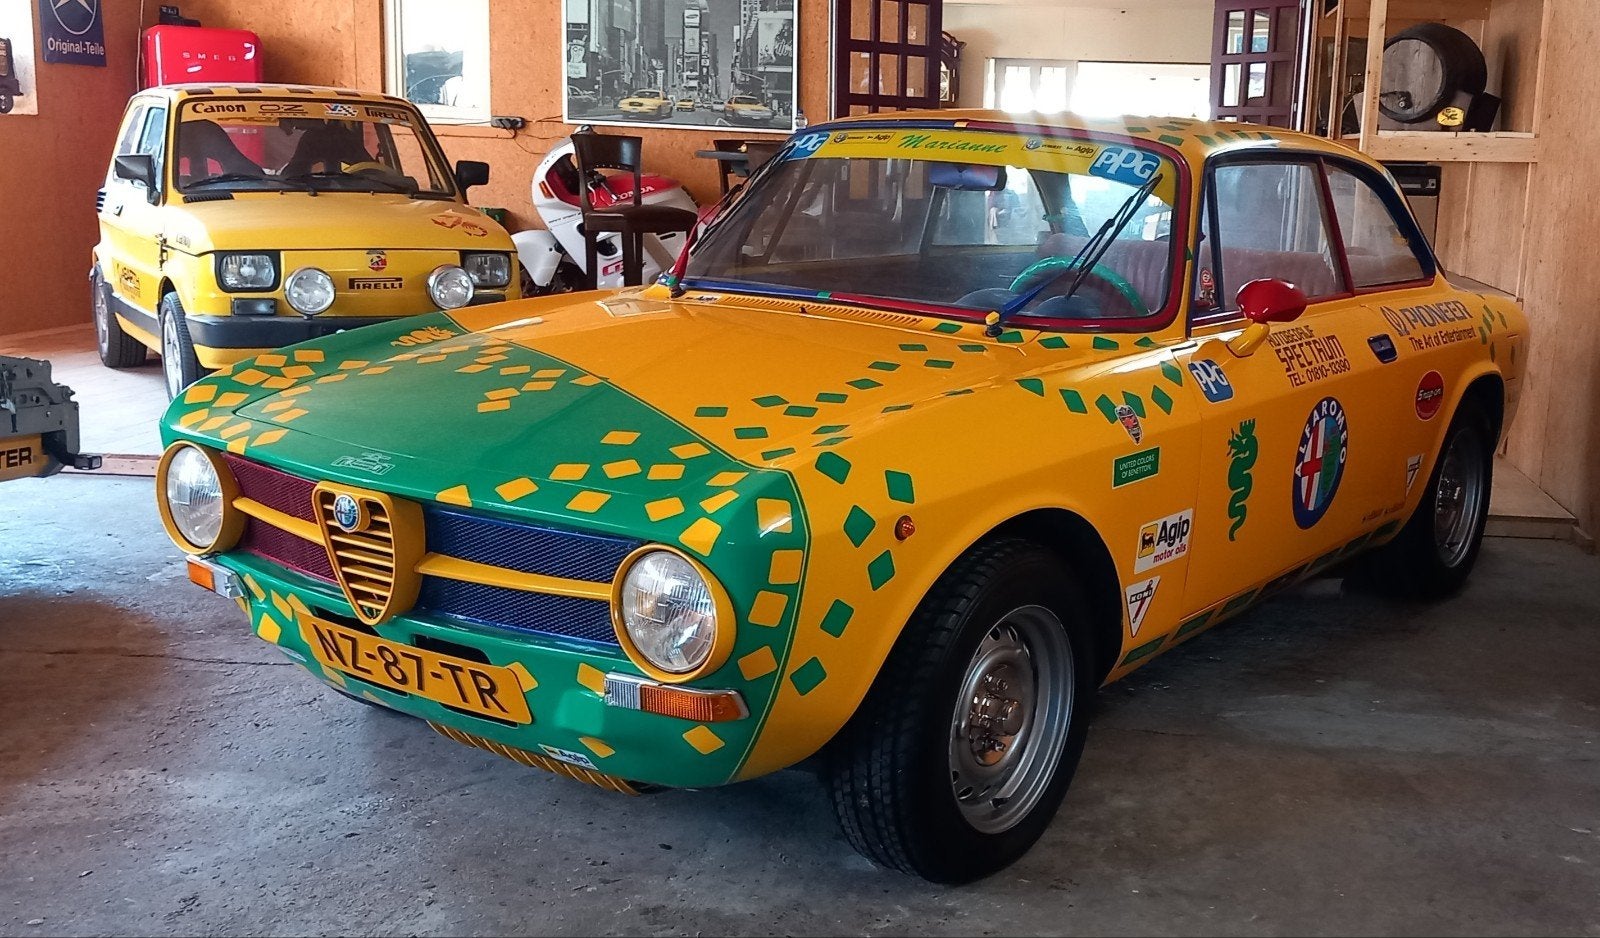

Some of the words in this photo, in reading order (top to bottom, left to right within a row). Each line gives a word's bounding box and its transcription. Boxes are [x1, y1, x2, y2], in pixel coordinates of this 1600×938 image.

[47, 37, 105, 55] Original-Teile
[182, 51, 236, 61] SMEG
[192, 103, 246, 114] Canon
[365, 106, 409, 122] PIRELLI
[898, 134, 1008, 153] Marianne
[1074, 145, 1094, 154] Agip
[1094, 147, 1157, 179] PPG
[348, 277, 403, 290] PIRELLI
[1399, 300, 1474, 330] PIONEER
[1408, 336, 1424, 352] The
[1422, 334, 1435, 349] Art
[1433, 332, 1442, 346] of
[1438, 325, 1477, 345] Entertainment
[1274, 334, 1346, 373] SPECTRUM
[1192, 361, 1229, 395] PPG
[1119, 459, 1137, 471] UNITED
[1136, 454, 1155, 466] COLORS
[1121, 470, 1128, 479] OF
[1156, 515, 1190, 547] Agip
[1153, 548, 1173, 564] motor
[1175, 543, 1187, 555] oils
[1131, 589, 1152, 602] KONI
[312, 623, 509, 714] NZ-87-TR
